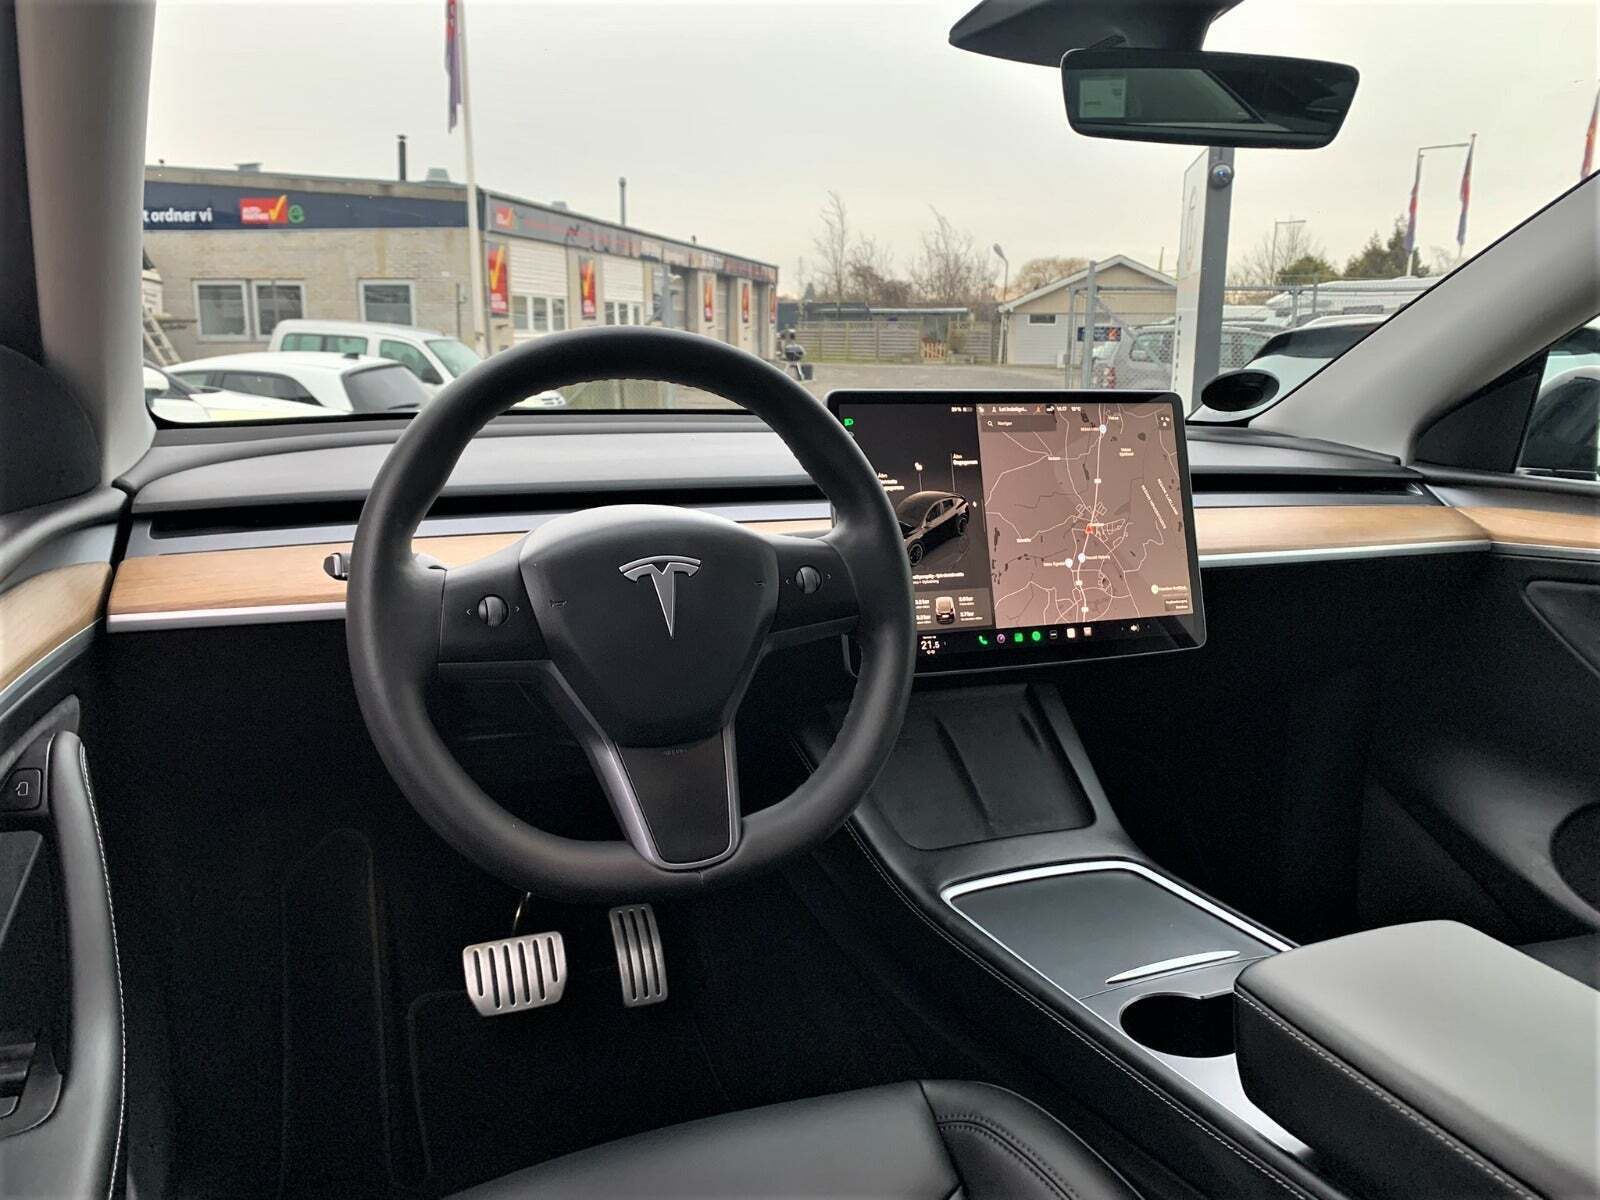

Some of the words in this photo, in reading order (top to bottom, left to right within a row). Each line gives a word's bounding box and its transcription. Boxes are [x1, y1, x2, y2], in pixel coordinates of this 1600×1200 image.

[151, 207, 196, 222] ordner
[199, 207, 213, 222] vi
[920, 640, 940, 650] 21.5
